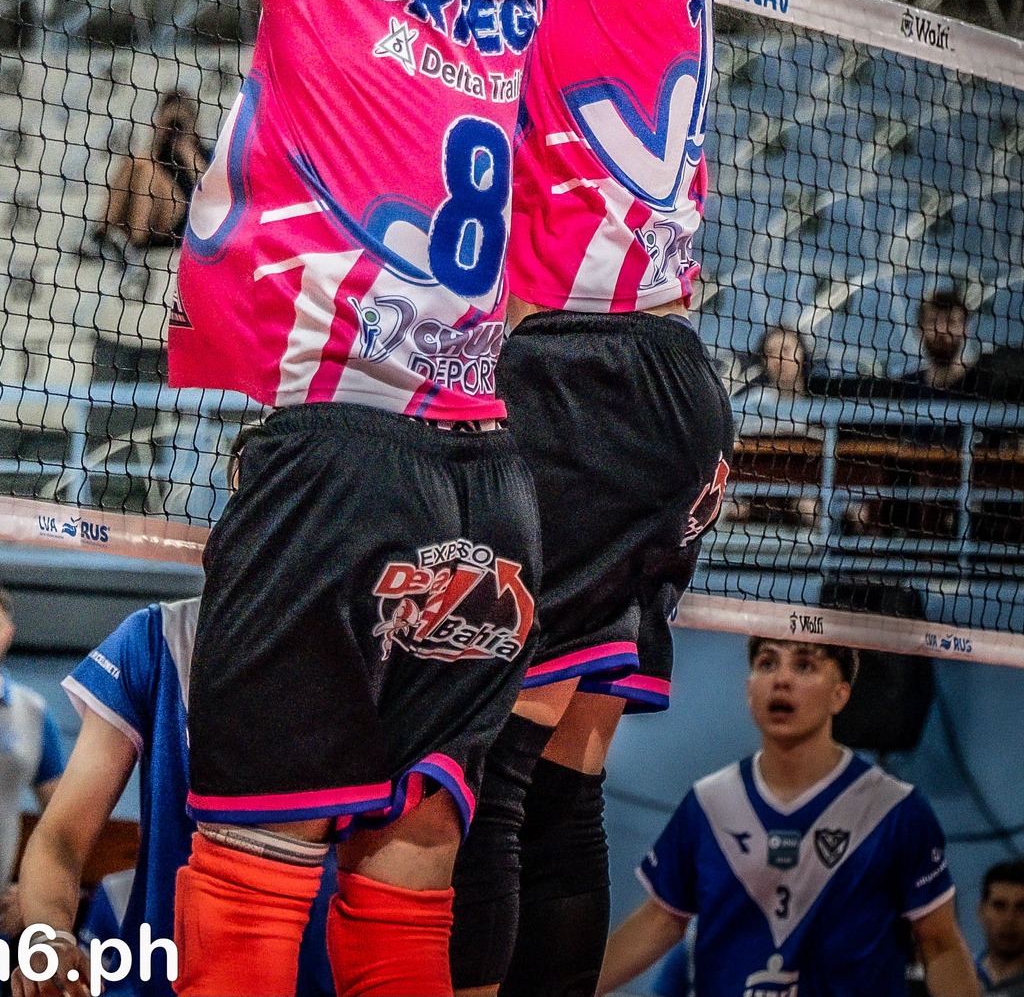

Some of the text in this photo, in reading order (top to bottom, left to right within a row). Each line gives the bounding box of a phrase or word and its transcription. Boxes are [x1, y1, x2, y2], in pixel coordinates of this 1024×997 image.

[915, 16, 951, 50] Wolfi
[419, 44, 486, 100] Delta
[428, 115, 512, 299] 8
[38, 515, 58, 532] LVA
[81, 521, 109, 543] RUS
[801, 615, 824, 635] Wolfi
[775, 886, 791, 919] 3
